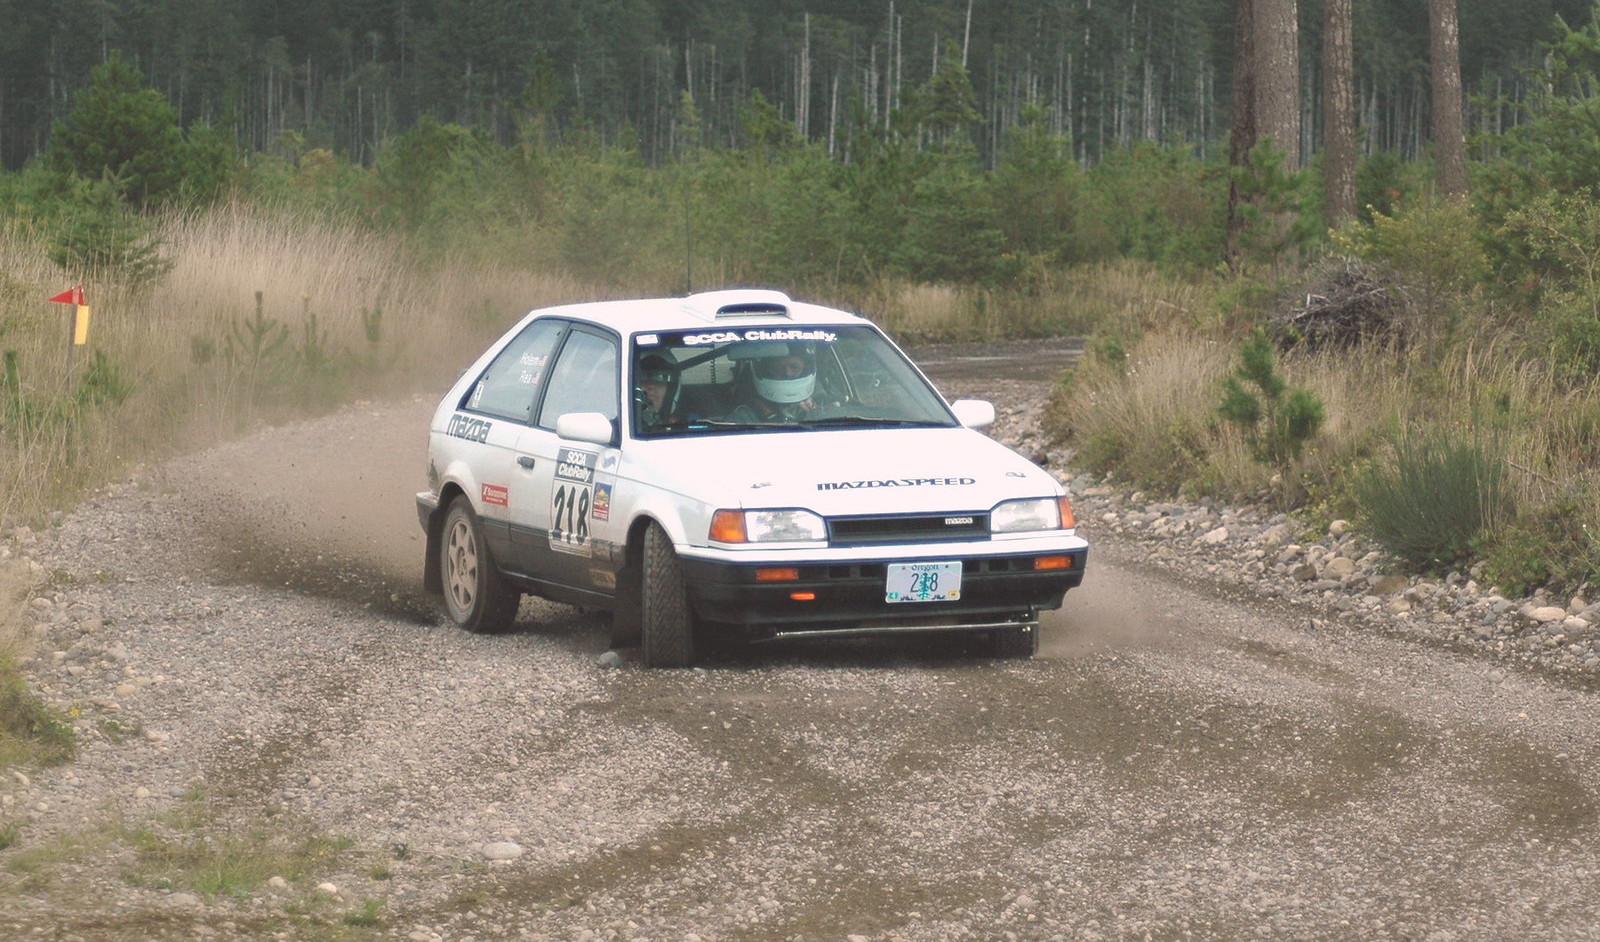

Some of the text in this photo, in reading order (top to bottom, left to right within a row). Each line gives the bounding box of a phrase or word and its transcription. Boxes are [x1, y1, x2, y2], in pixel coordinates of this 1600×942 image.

[566, 451, 587, 466] SCCA
[558, 463, 591, 482] ClubRally
[554, 484, 589, 546] 218
